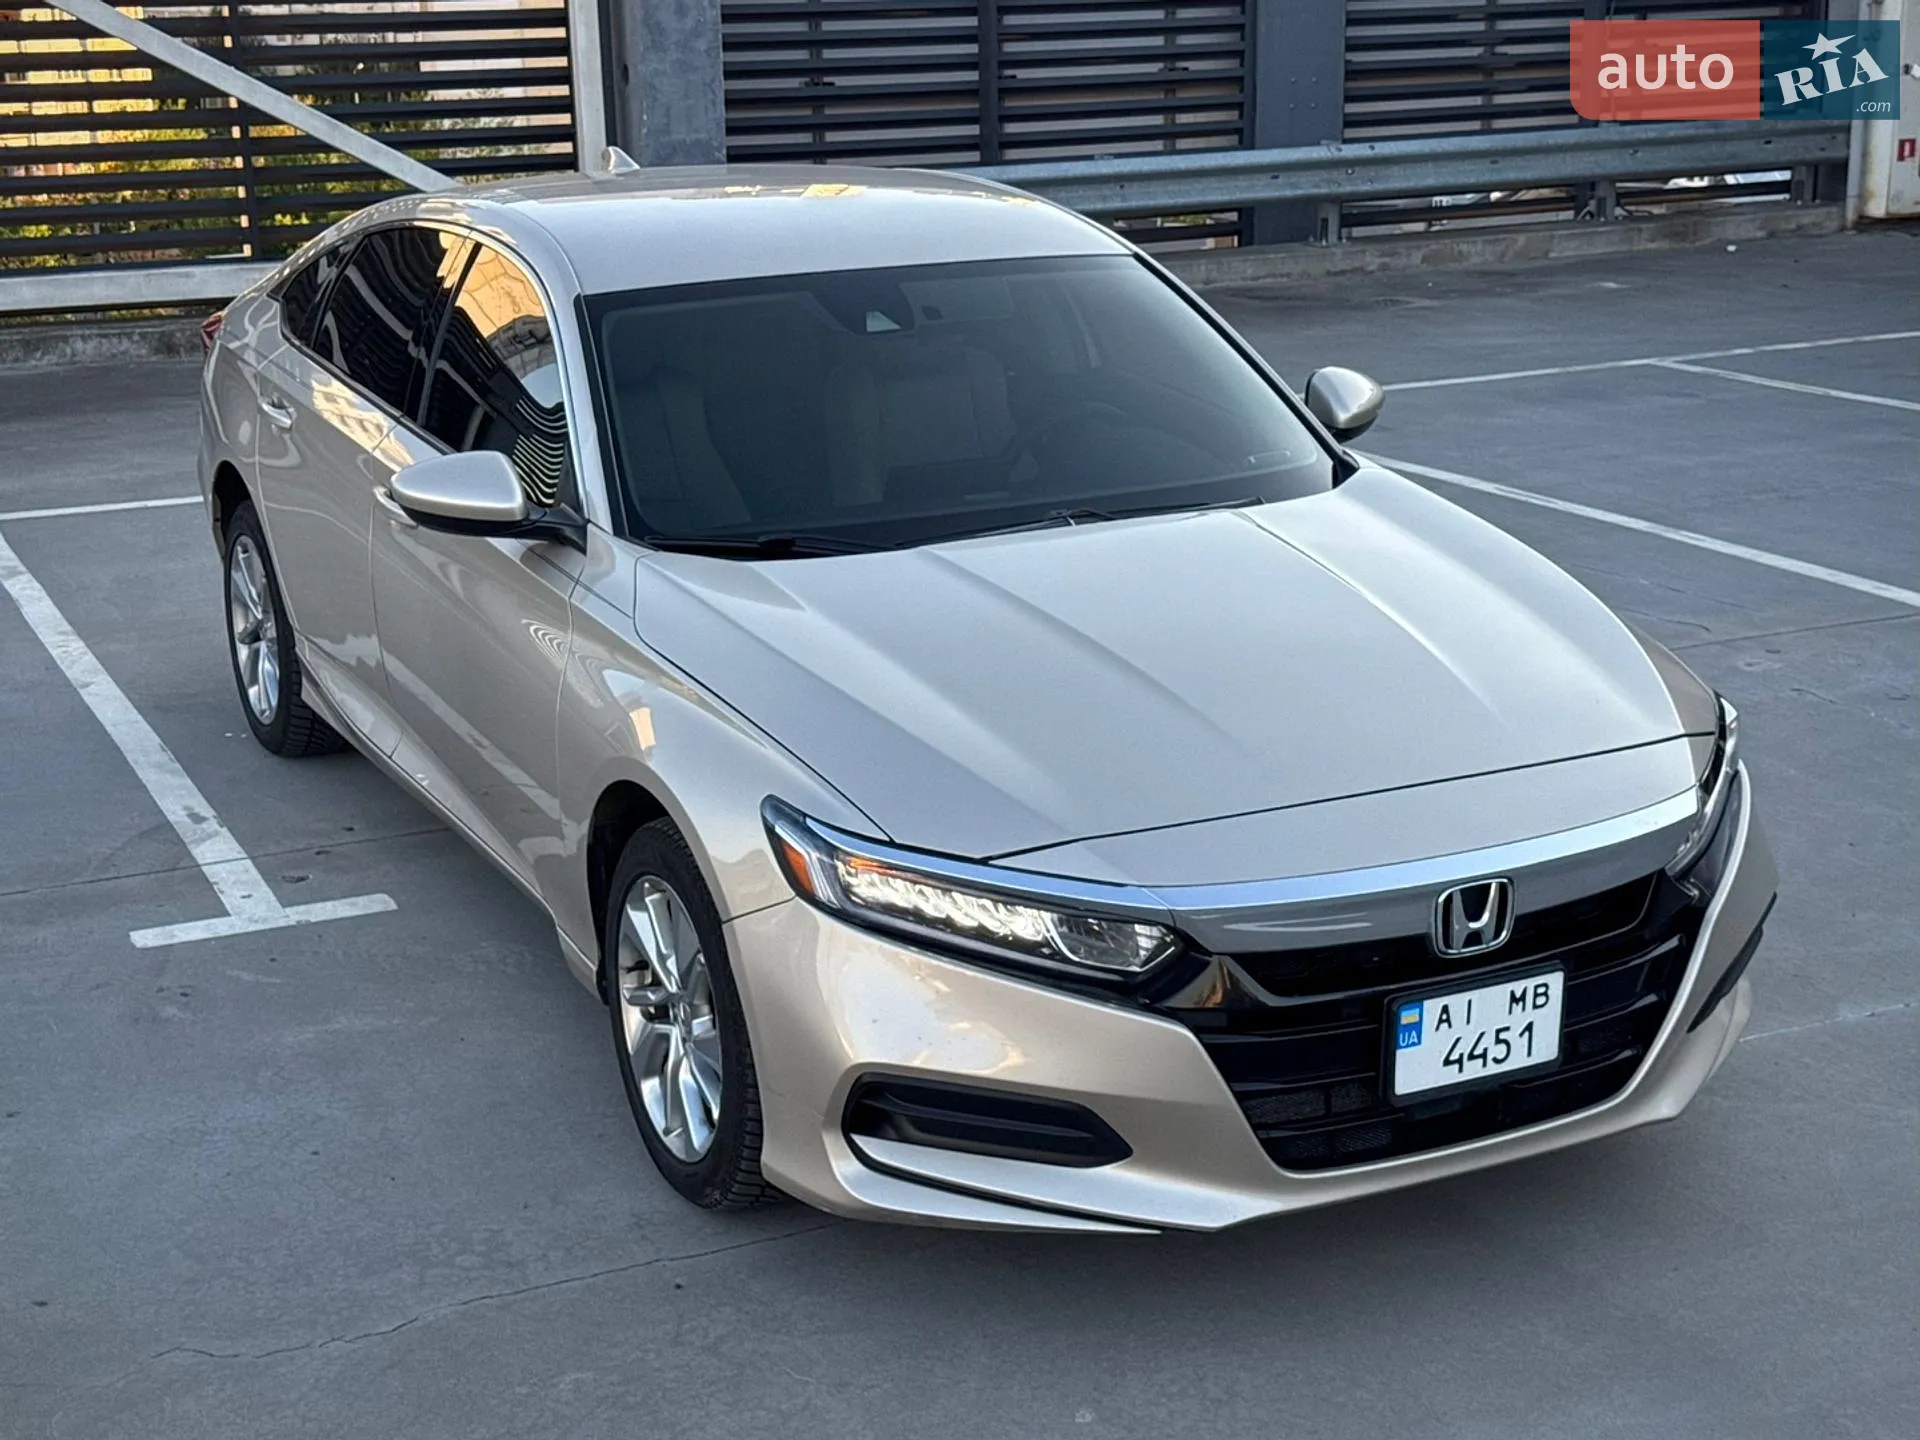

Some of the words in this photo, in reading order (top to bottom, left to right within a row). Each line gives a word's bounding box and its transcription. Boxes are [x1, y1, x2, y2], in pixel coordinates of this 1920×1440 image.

[1435, 999, 1472, 1032] AI
[1508, 982, 1550, 1016] MB
[1399, 1030, 1419, 1047] UA
[1442, 1020, 1535, 1074] 4451
